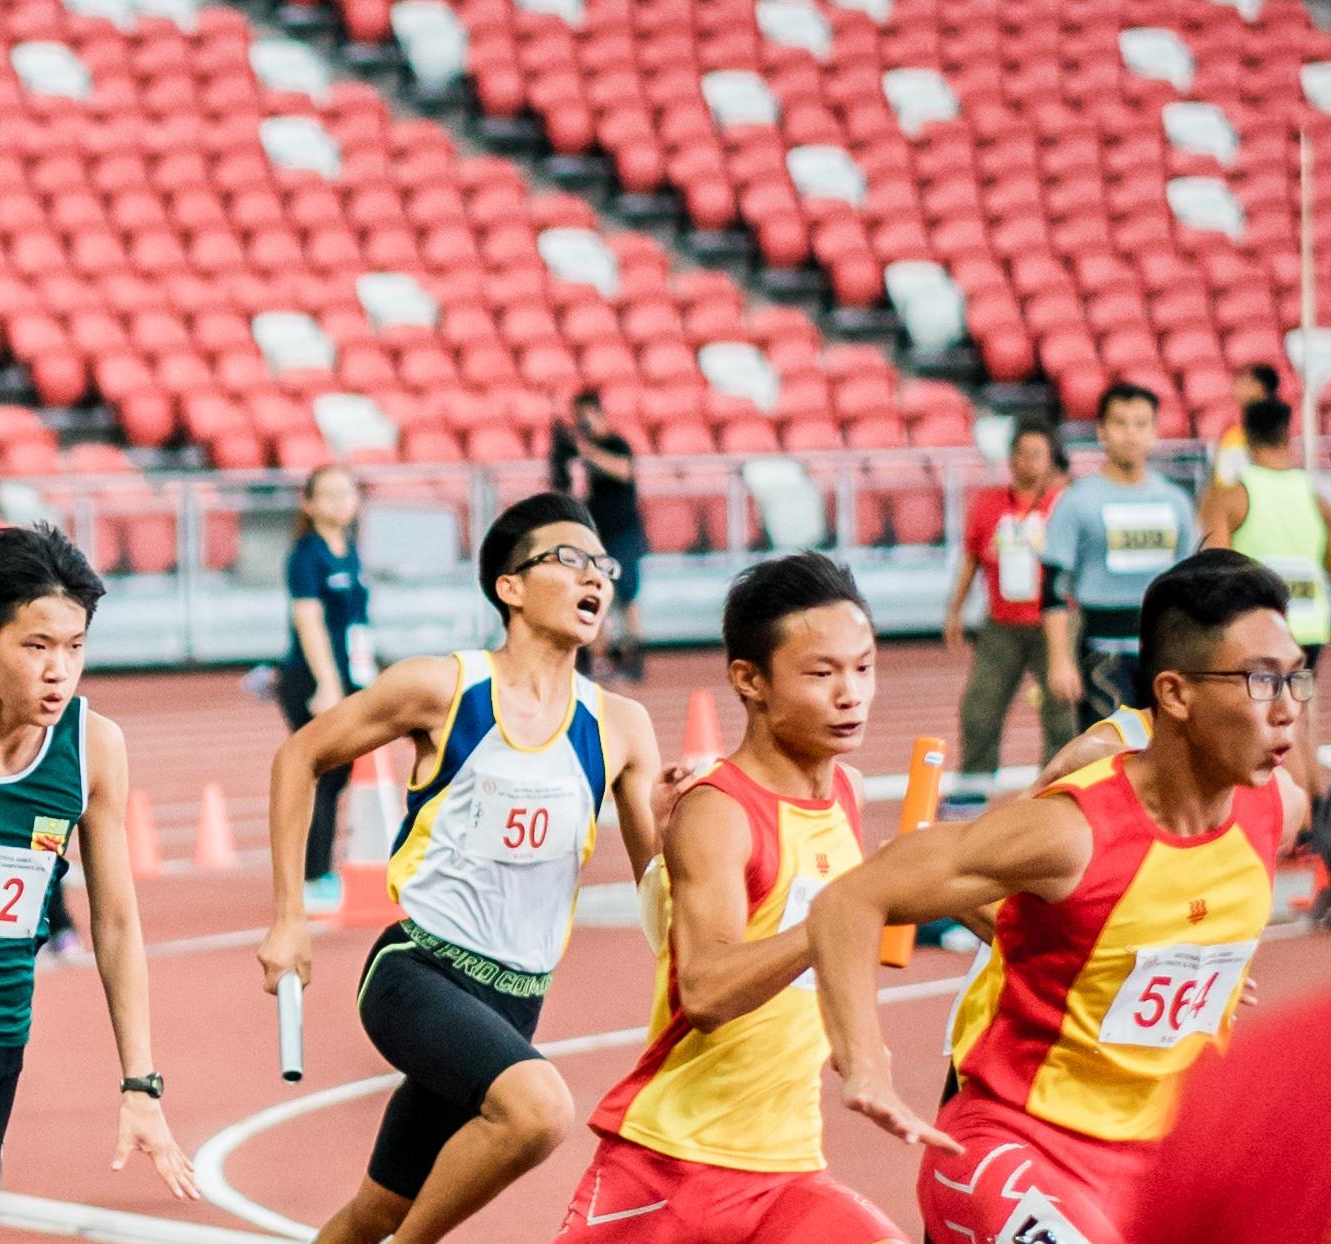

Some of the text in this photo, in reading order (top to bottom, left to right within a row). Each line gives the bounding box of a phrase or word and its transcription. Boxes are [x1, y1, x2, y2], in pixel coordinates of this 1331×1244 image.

[503, 808, 549, 849] 50
[433, 942, 499, 985] PRO
[494, 969, 553, 998] COM
[1133, 972, 1220, 1030] 564
